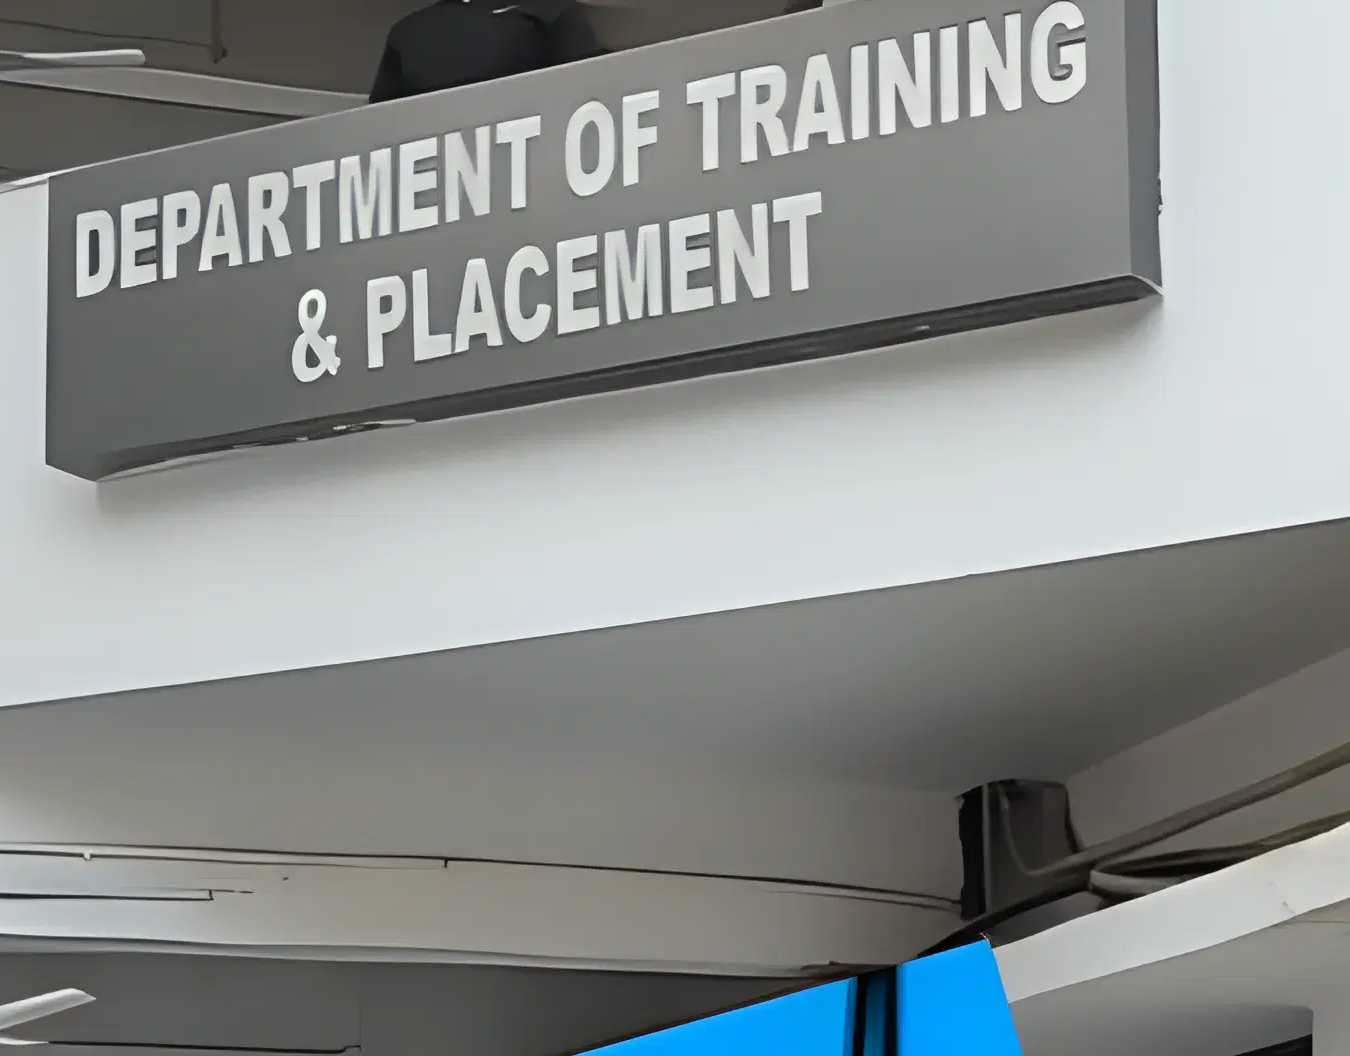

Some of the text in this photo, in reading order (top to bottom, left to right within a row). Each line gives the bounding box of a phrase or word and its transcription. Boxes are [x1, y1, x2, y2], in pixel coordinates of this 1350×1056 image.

[75, 0, 1087, 298] DEPARTMENT OF TRAINING
[292, 191, 822, 384] & PLACEMENT
